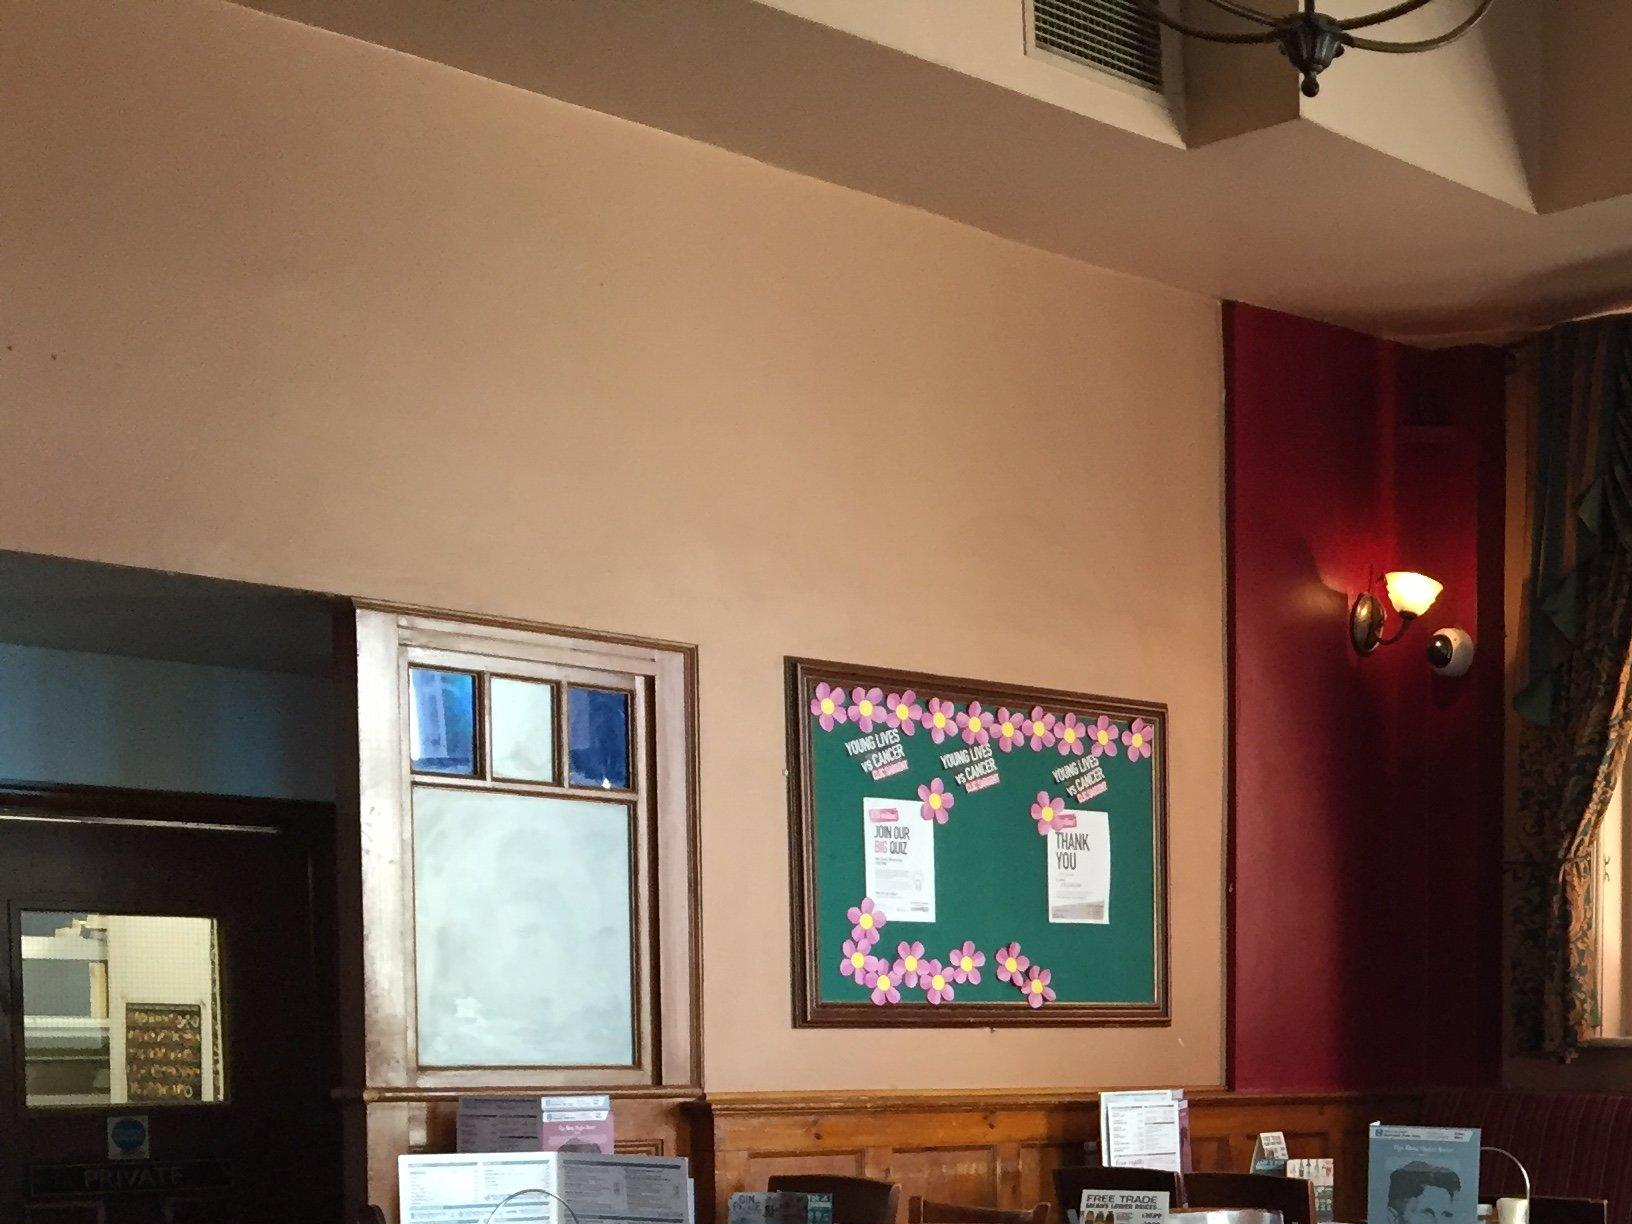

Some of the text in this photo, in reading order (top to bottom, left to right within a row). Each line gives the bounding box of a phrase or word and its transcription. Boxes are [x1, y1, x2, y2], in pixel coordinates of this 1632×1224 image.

[845, 729, 900, 756] YOUNG LIVES
[872, 744, 905, 768] CANCER
[940, 743, 993, 769] YOUNG LIVES
[965, 758, 998, 781] CANCER
[874, 825, 910, 840] JOIN OUR
[1055, 832, 1090, 851] THANK
[890, 841, 907, 855] QUIZ
[1056, 852, 1077, 870] YOU
[1087, 1194, 1158, 1204] FREE TRADE
